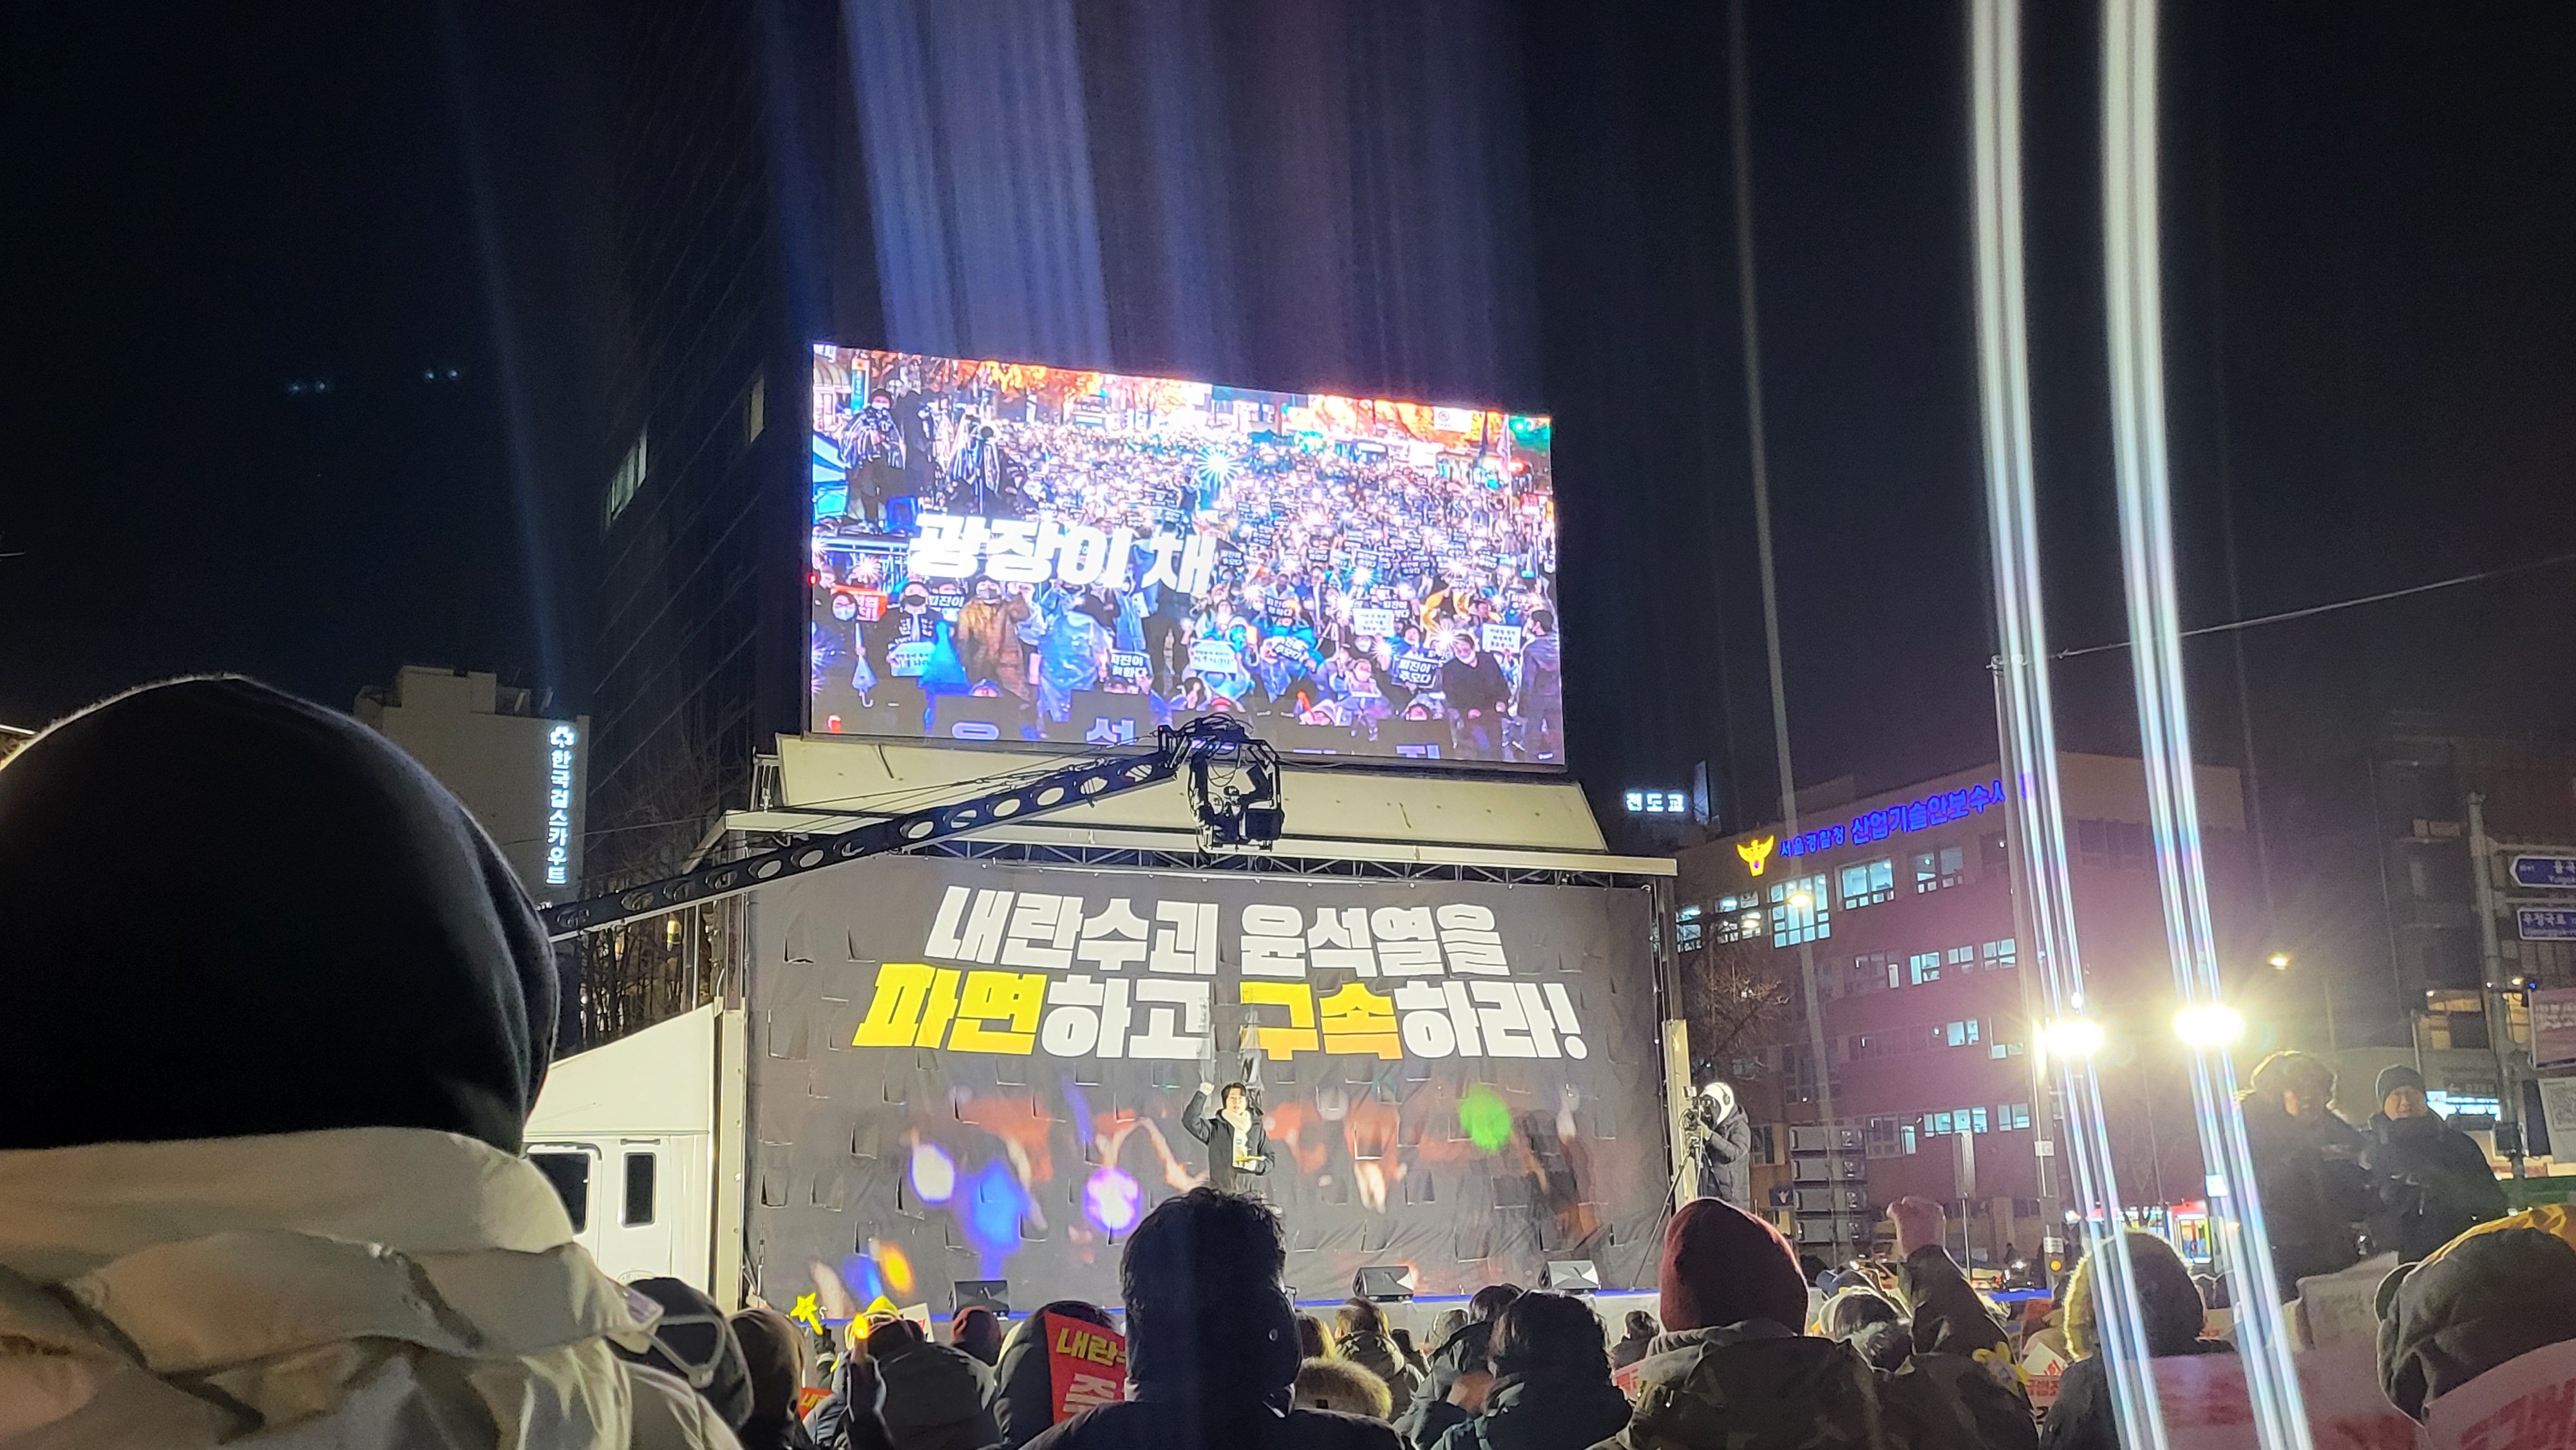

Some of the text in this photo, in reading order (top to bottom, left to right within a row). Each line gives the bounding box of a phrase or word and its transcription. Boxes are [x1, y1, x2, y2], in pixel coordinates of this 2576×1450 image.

[907, 515, 1219, 594] 광장이 채
[546, 750, 573, 885] 한국걸스카우트
[1626, 793, 1685, 813] 천도교
[1779, 774, 2033, 858] 서울경찰청 산업기술안보수사
[923, 885, 1511, 977] 내란수괴 윤석열을
[851, 963, 1588, 1060] 파면하고 구속하라!
[1056, 1327, 1126, 1366] 내란
